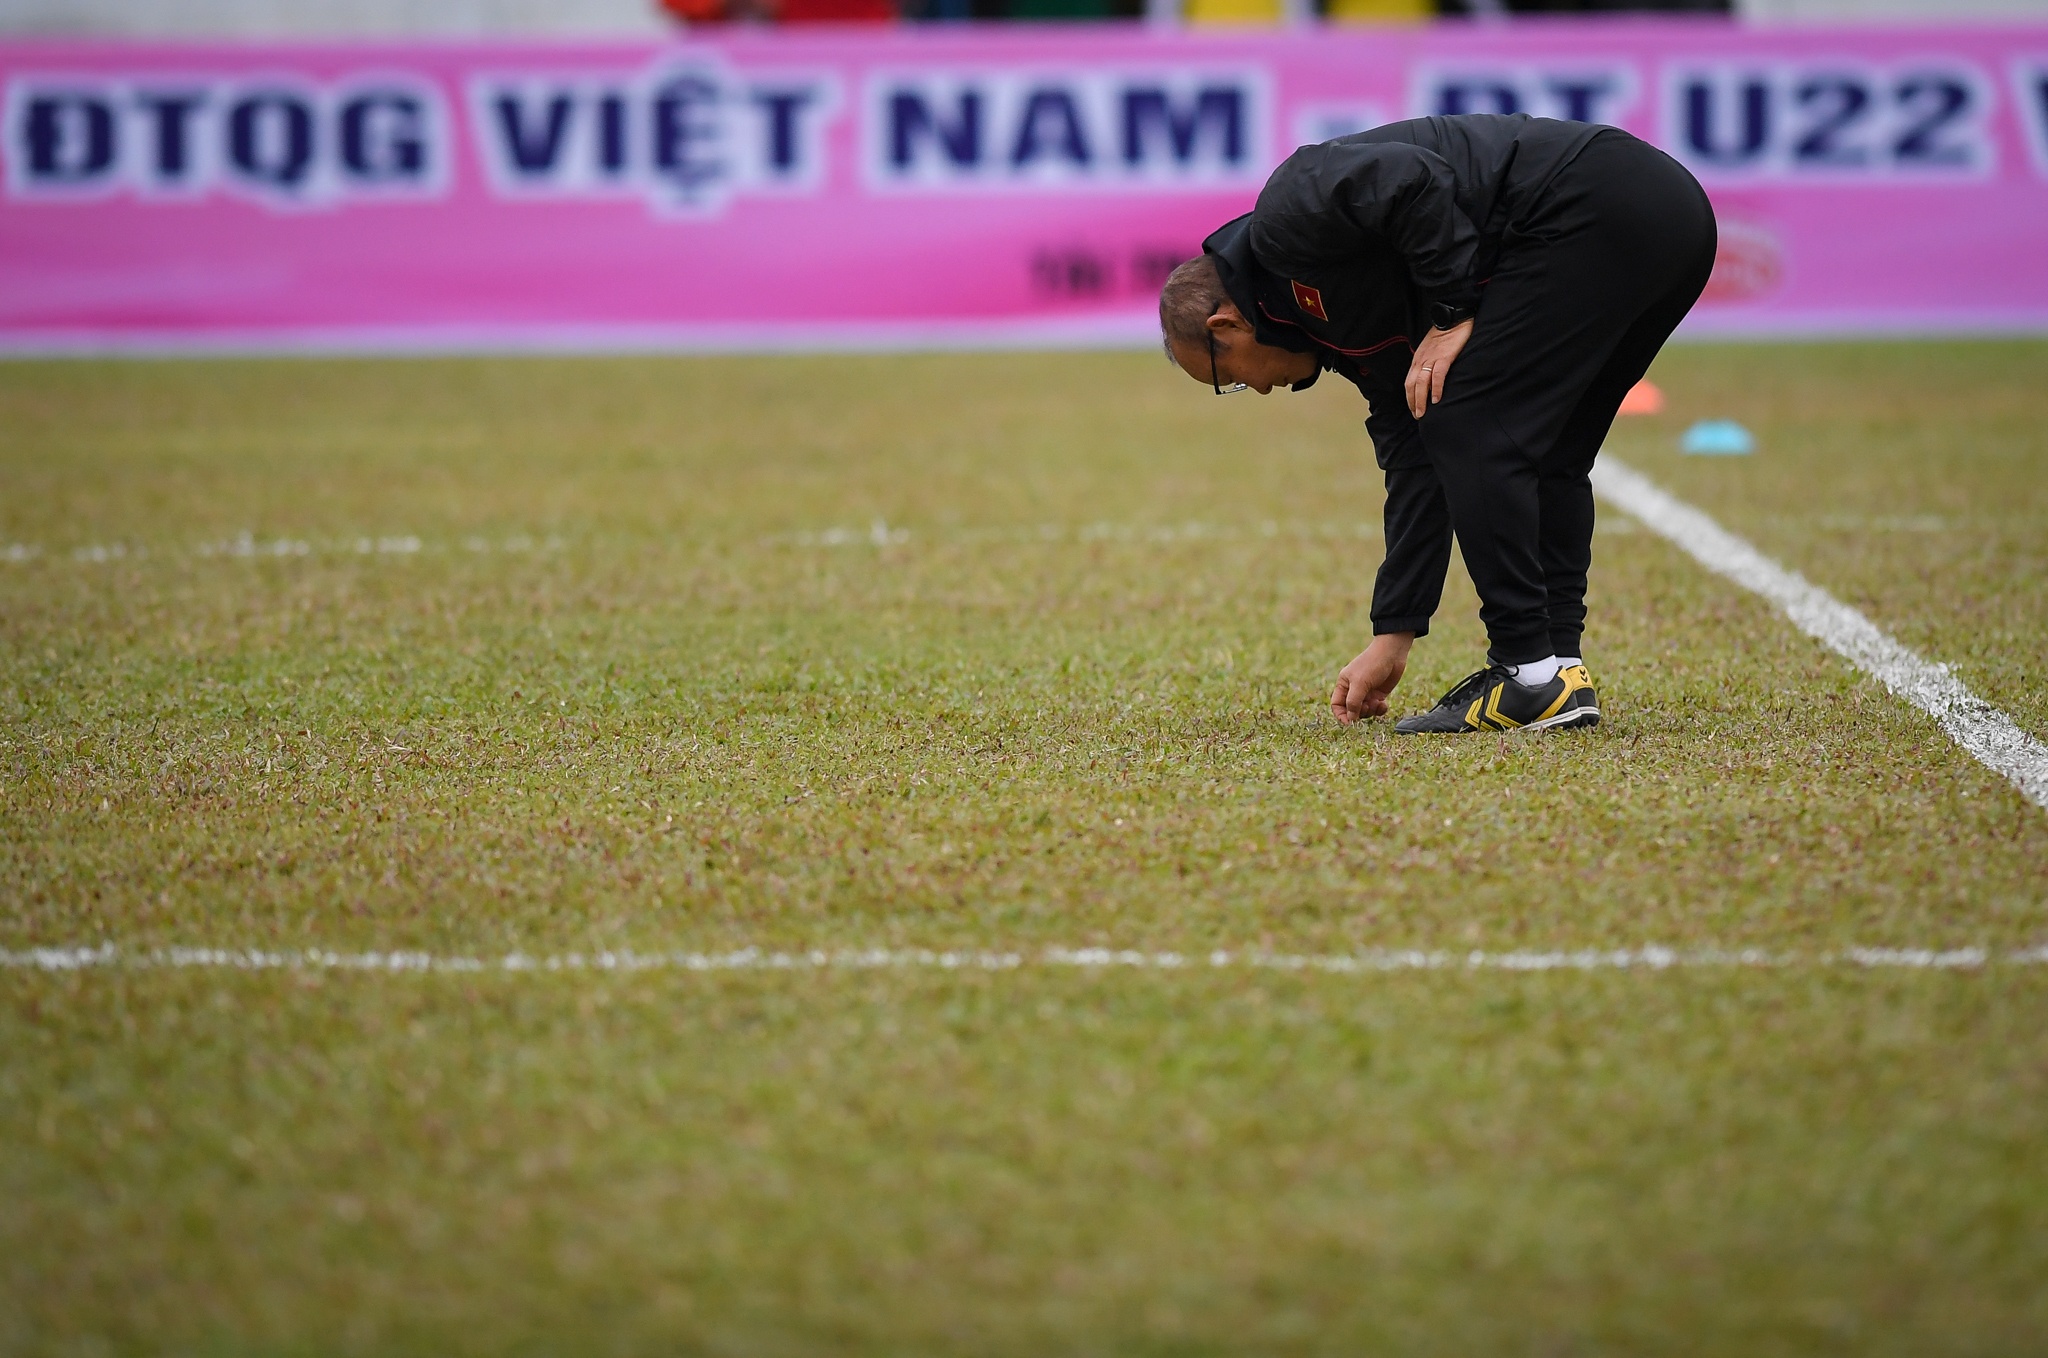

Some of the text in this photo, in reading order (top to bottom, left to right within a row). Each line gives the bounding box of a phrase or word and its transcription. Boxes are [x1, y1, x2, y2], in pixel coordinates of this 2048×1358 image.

[18, 88, 430, 190] ĐTQG
[490, 65, 820, 206] VIỆT
[884, 80, 1254, 174] NAM
[1680, 70, 1978, 170] U22
